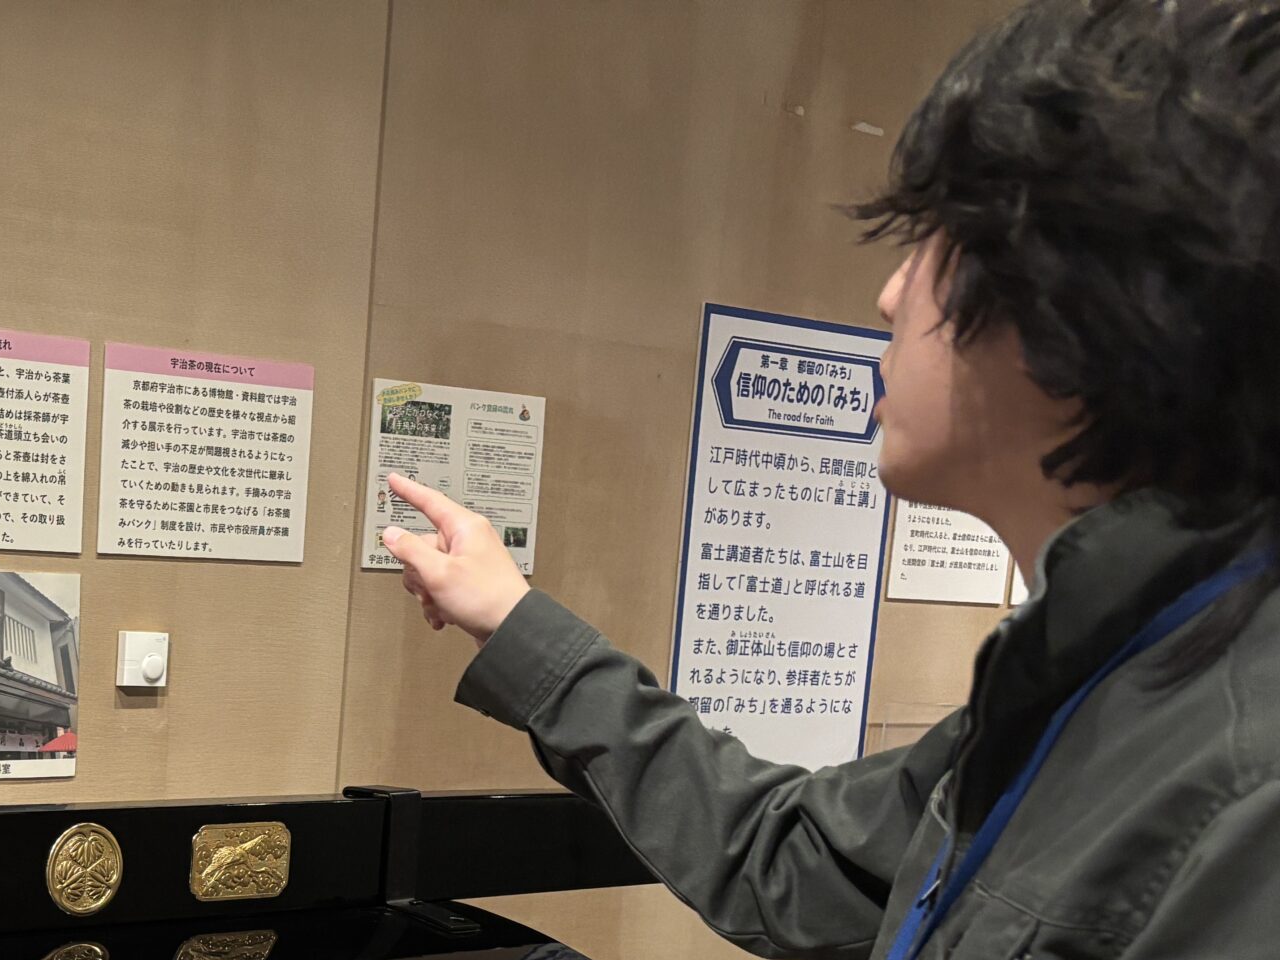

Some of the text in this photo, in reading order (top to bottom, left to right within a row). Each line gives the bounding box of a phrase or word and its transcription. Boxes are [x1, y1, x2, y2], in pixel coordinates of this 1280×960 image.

[170, 357, 256, 377] 宇治茶の現在について
[760, 354, 852, 380] 第一章 都留の「みち」
[736, 372, 870, 412] 信仰のための「みち」
[768, 409, 834, 426] The road for Faith
[121, 458, 292, 482] たことで、宇治の歴史や文化を次世代に継承し
[709, 446, 877, 479] 江戸時代中頃から、民間信仰と
[707, 477, 877, 510] して広まったものに「富士講」
[704, 507, 771, 530] があります。
[117, 537, 213, 553] みを行っていたりします。
[700, 542, 869, 570] 富士講道者たちは、富士山を目
[698, 572, 866, 599] 指して「富士道」と呼ばれる道
[695, 603, 775, 624] を通りました。
[692, 637, 859, 660] また、御正体山も信仰の場とさ
[689, 668, 856, 687] れるようになり、参拝者たちが
